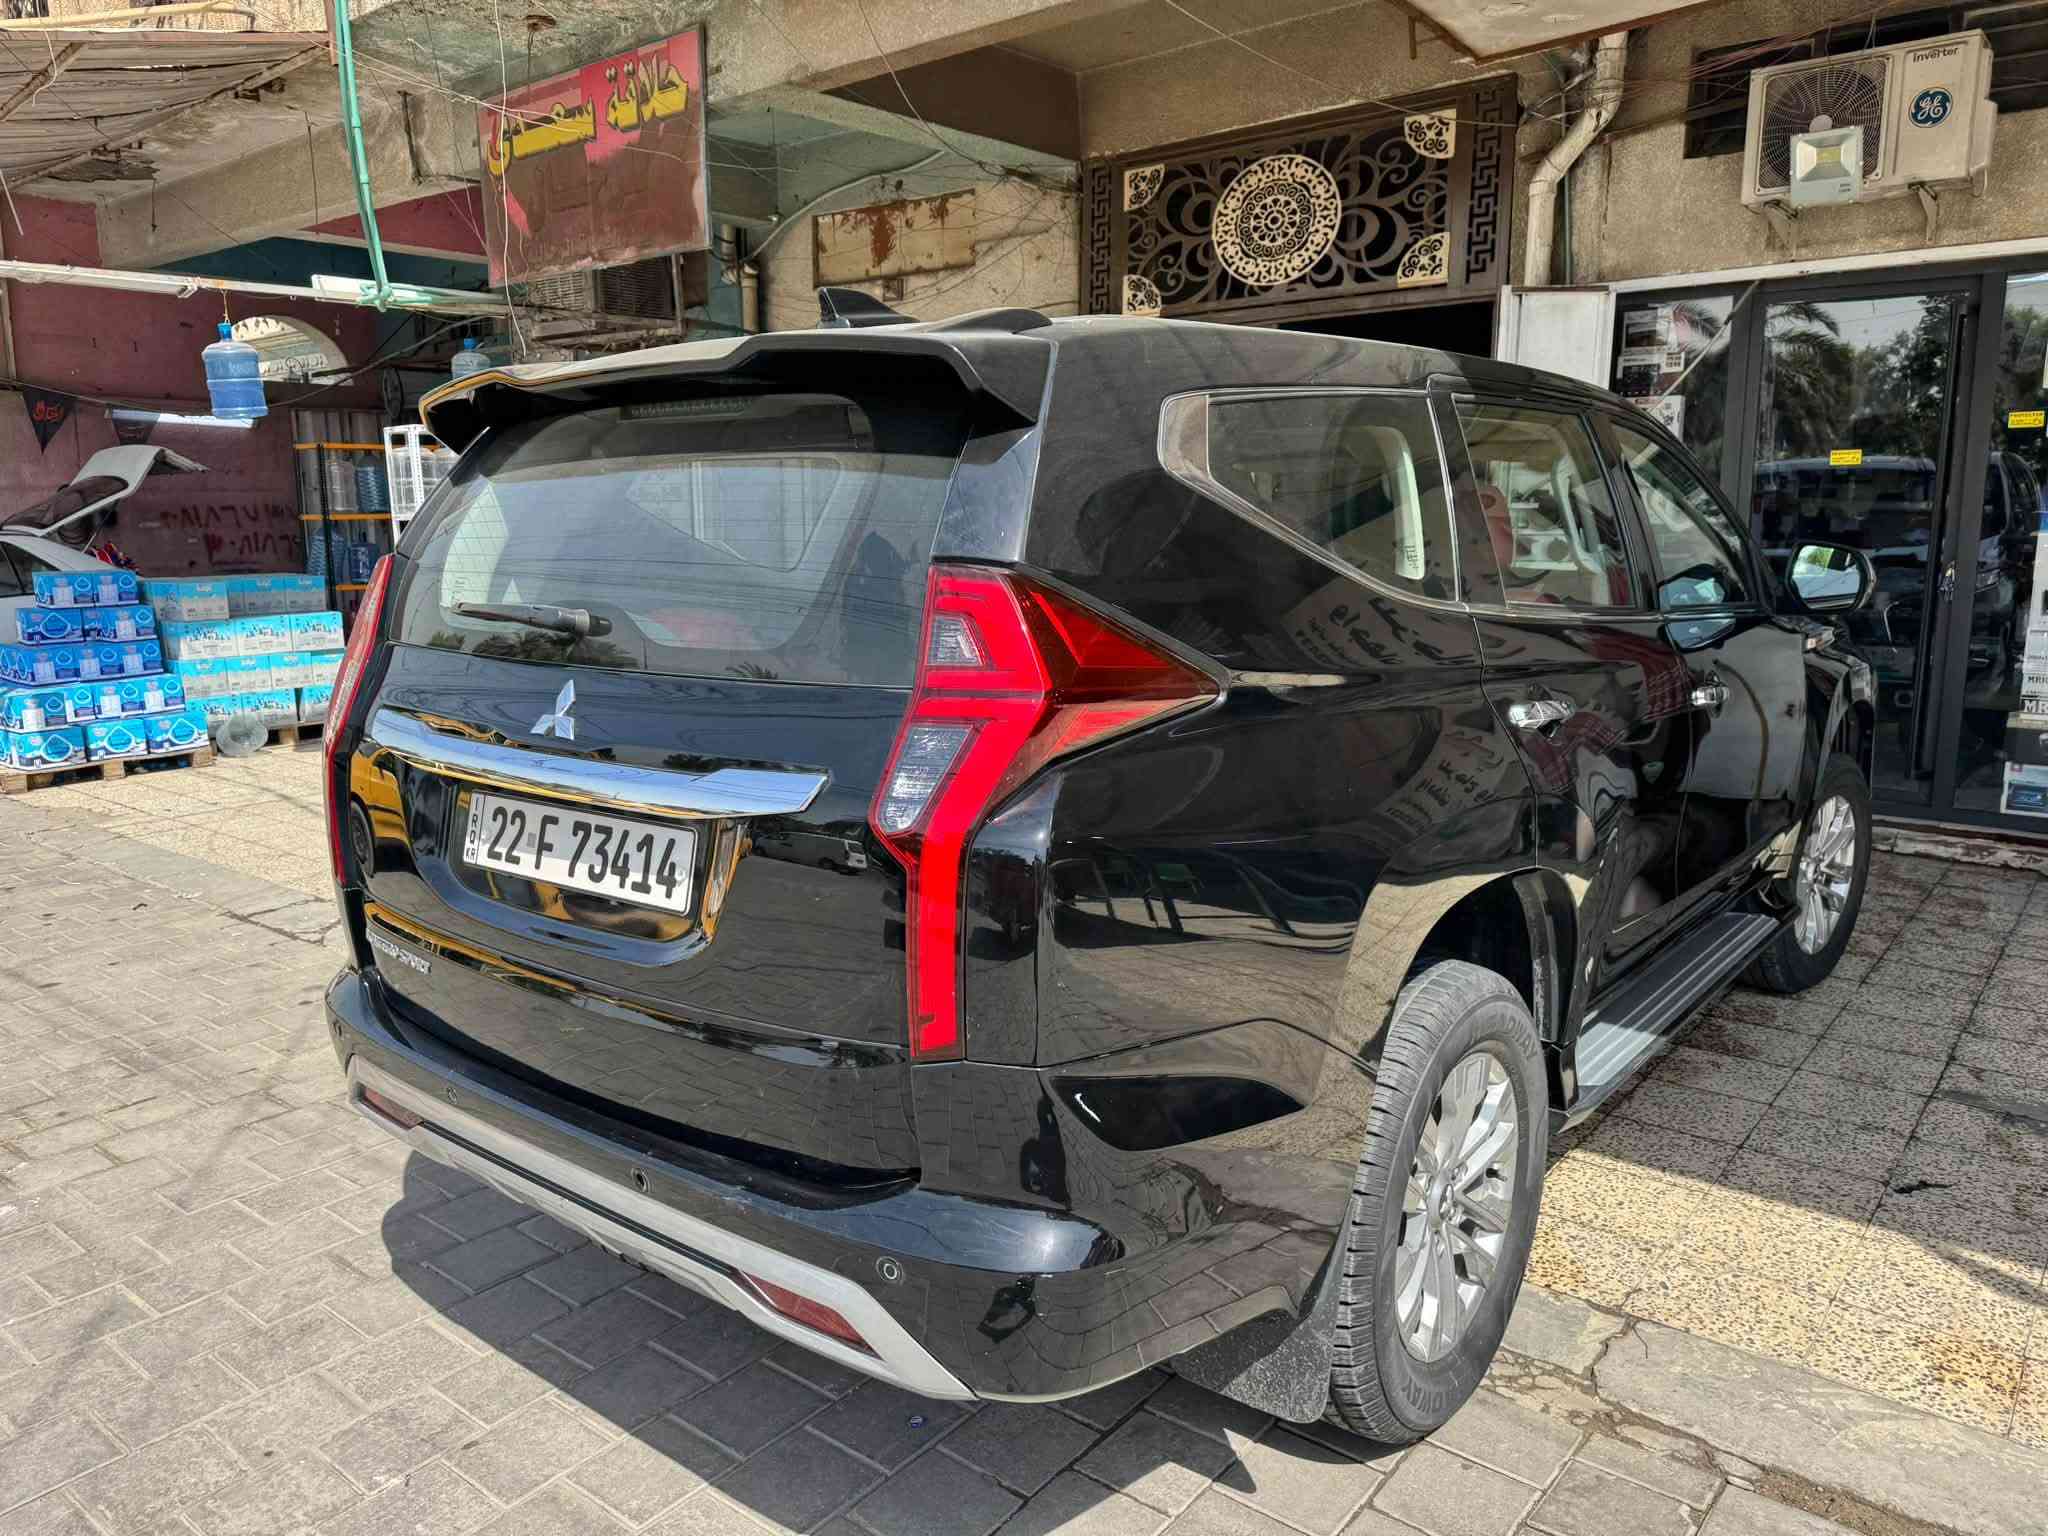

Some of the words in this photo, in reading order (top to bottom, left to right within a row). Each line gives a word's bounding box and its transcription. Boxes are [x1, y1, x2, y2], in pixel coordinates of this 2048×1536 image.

[606, 53, 690, 132] حلاقة
[487, 805, 527, 865] 22
[534, 814, 560, 870] F
[567, 820, 677, 899] 73414
